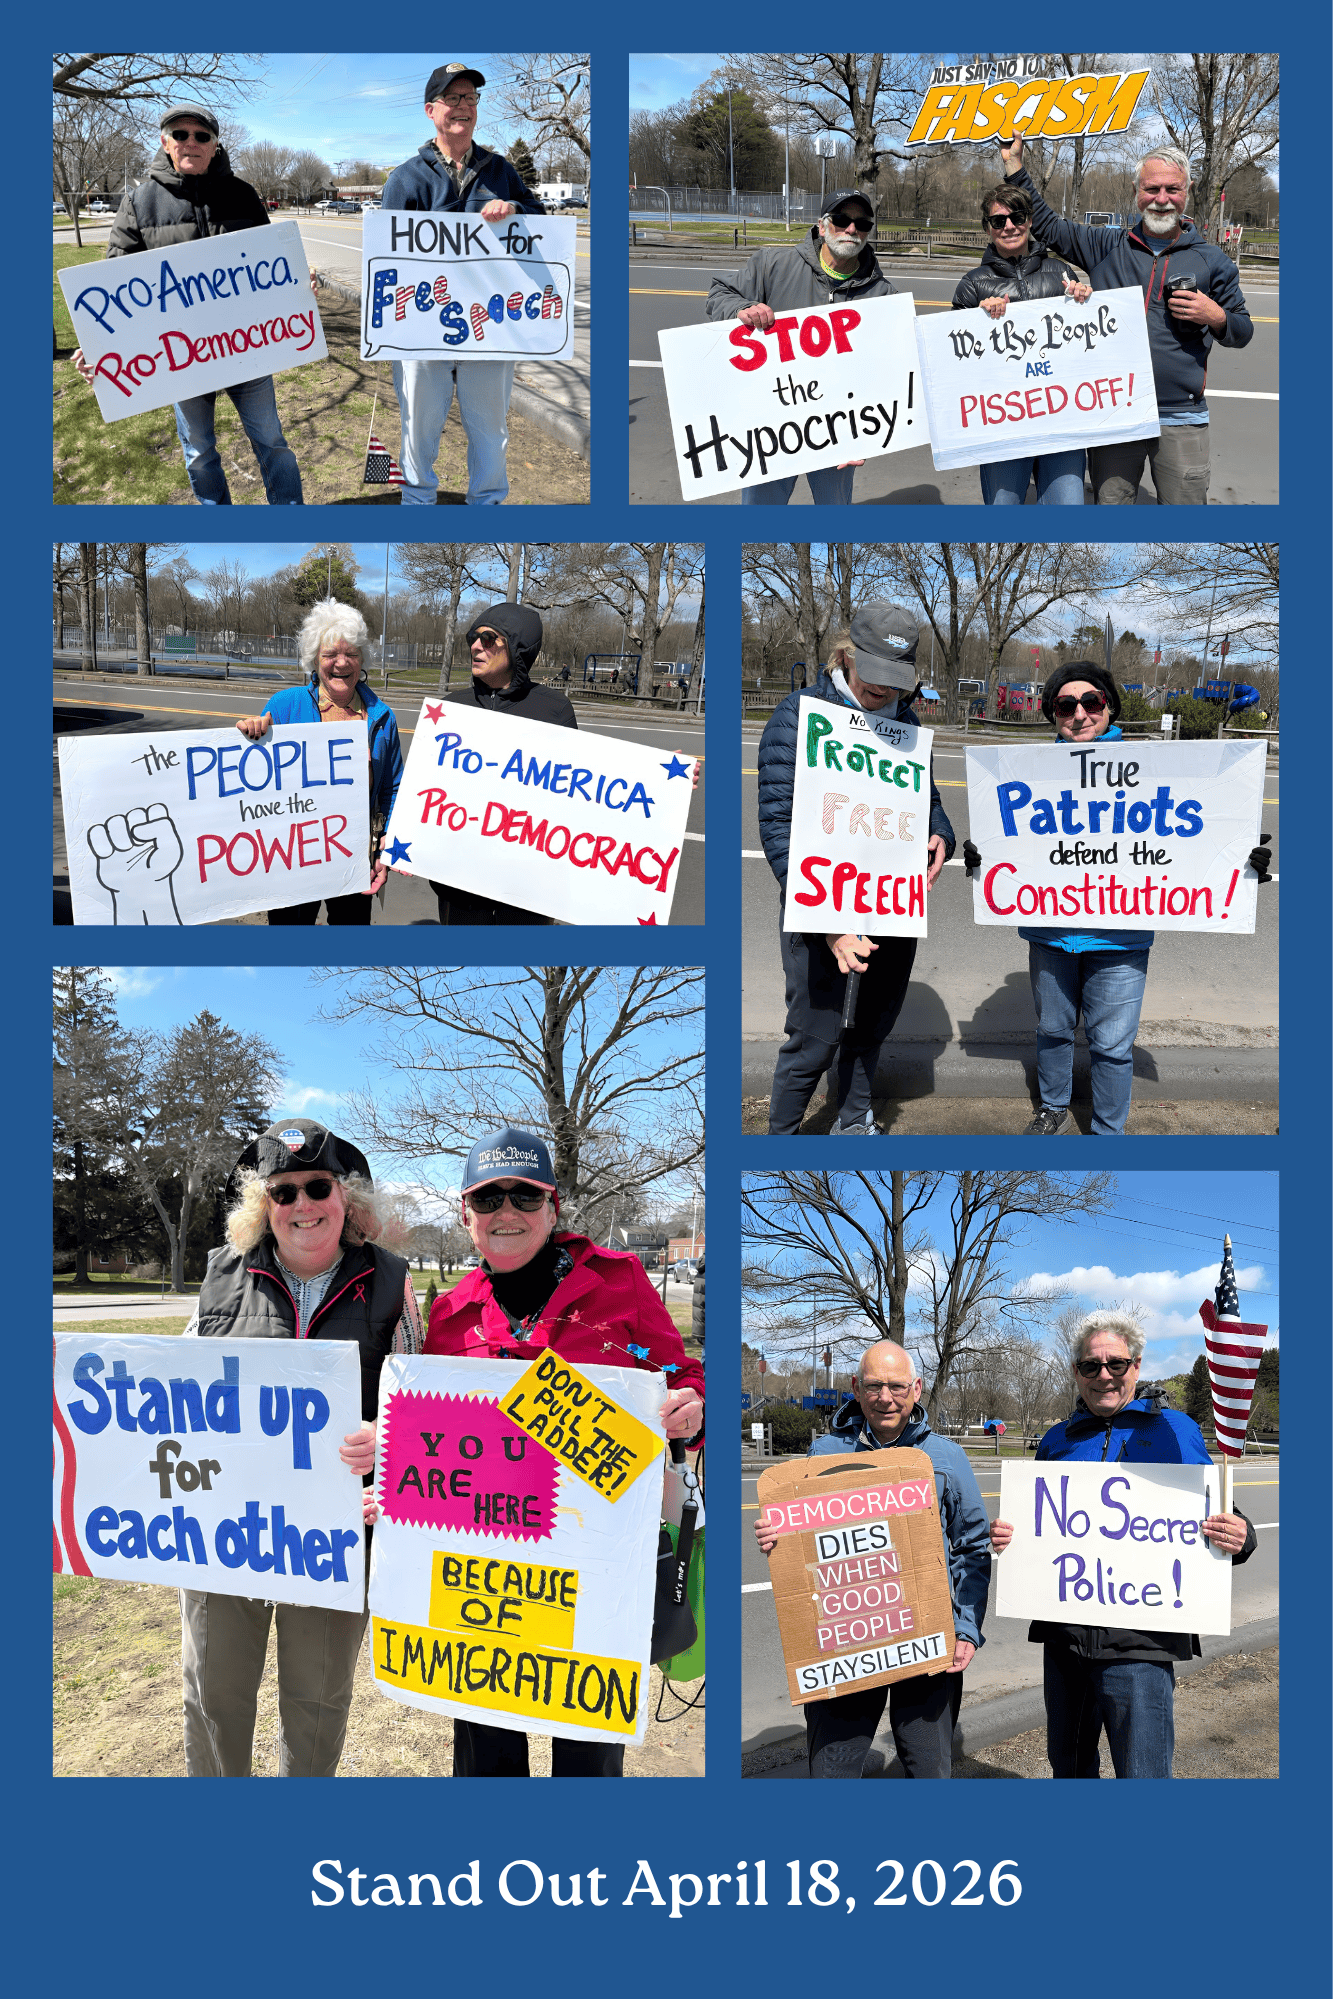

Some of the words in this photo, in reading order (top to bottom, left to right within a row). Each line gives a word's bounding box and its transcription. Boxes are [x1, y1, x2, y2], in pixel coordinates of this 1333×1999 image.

[931, 65, 963, 85] JUST
[965, 63, 992, 82] SAY
[996, 60, 1018, 79] NO
[907, 70, 1150, 143] FASCISM
[391, 215, 490, 256] HONK
[498, 222, 544, 255] for
[371, 268, 451, 329] Free
[439, 284, 563, 346] Speech
[94, 310, 315, 397] Pro-Democracy
[728, 308, 862, 372] STOP
[948, 328, 986, 361] We
[989, 319, 1038, 362] the
[1039, 304, 1119, 359] People
[772, 374, 824, 406] the
[1025, 360, 1054, 378] ARE
[683, 371, 914, 479] Hypocrisy!
[959, 385, 1069, 429] PISSED
[1074, 373, 1135, 412] OFF!
[186, 738, 354, 801] PEOPLE
[434, 732, 656, 818] Pro-AMERICA
[806, 712, 926, 793] PROTECT
[1069, 748, 1140, 789] True
[239, 799, 285, 822] have
[285, 792, 318, 814] the
[821, 792, 917, 842] FREE
[996, 780, 1204, 838] Patriots
[196, 814, 354, 884] POWER
[416, 787, 680, 893] Pro-DEMOCRACY
[1049, 840, 1119, 866] defend
[1128, 840, 1173, 866] the
[794, 855, 925, 918] SPEECH
[983, 862, 1240, 920] Constitution!
[478, 1150, 491, 1163] We
[492, 1147, 506, 1161] the
[505, 1146, 539, 1162] People
[511, 1161, 539, 1169] ENOUGH
[67, 1352, 241, 1435] Stand
[259, 1384, 330, 1470] up
[535, 1355, 617, 1424] DON'T
[420, 1432, 528, 1461] YOU
[506, 1393, 628, 1496] LADDER!
[533, 1387, 582, 1437] PULL
[591, 1427, 638, 1471] THE
[149, 1439, 222, 1499] for
[397, 1465, 473, 1500] ARE
[474, 1492, 542, 1528] HERE
[766, 1483, 930, 1529] DEMOCRACY
[1034, 1475, 1091, 1539] No
[85, 1505, 209, 1566] each
[214, 1501, 360, 1583] other
[816, 1552, 898, 1588] WHEN
[819, 1524, 888, 1560] DIES
[442, 1556, 578, 1608] BECAUSE
[822, 1582, 901, 1616] GOOD
[1052, 1552, 1184, 1609] Police!
[460, 1598, 523, 1629] OF
[817, 1608, 914, 1649] PEOPLE
[380, 1627, 638, 1724] IMMIGRATION
